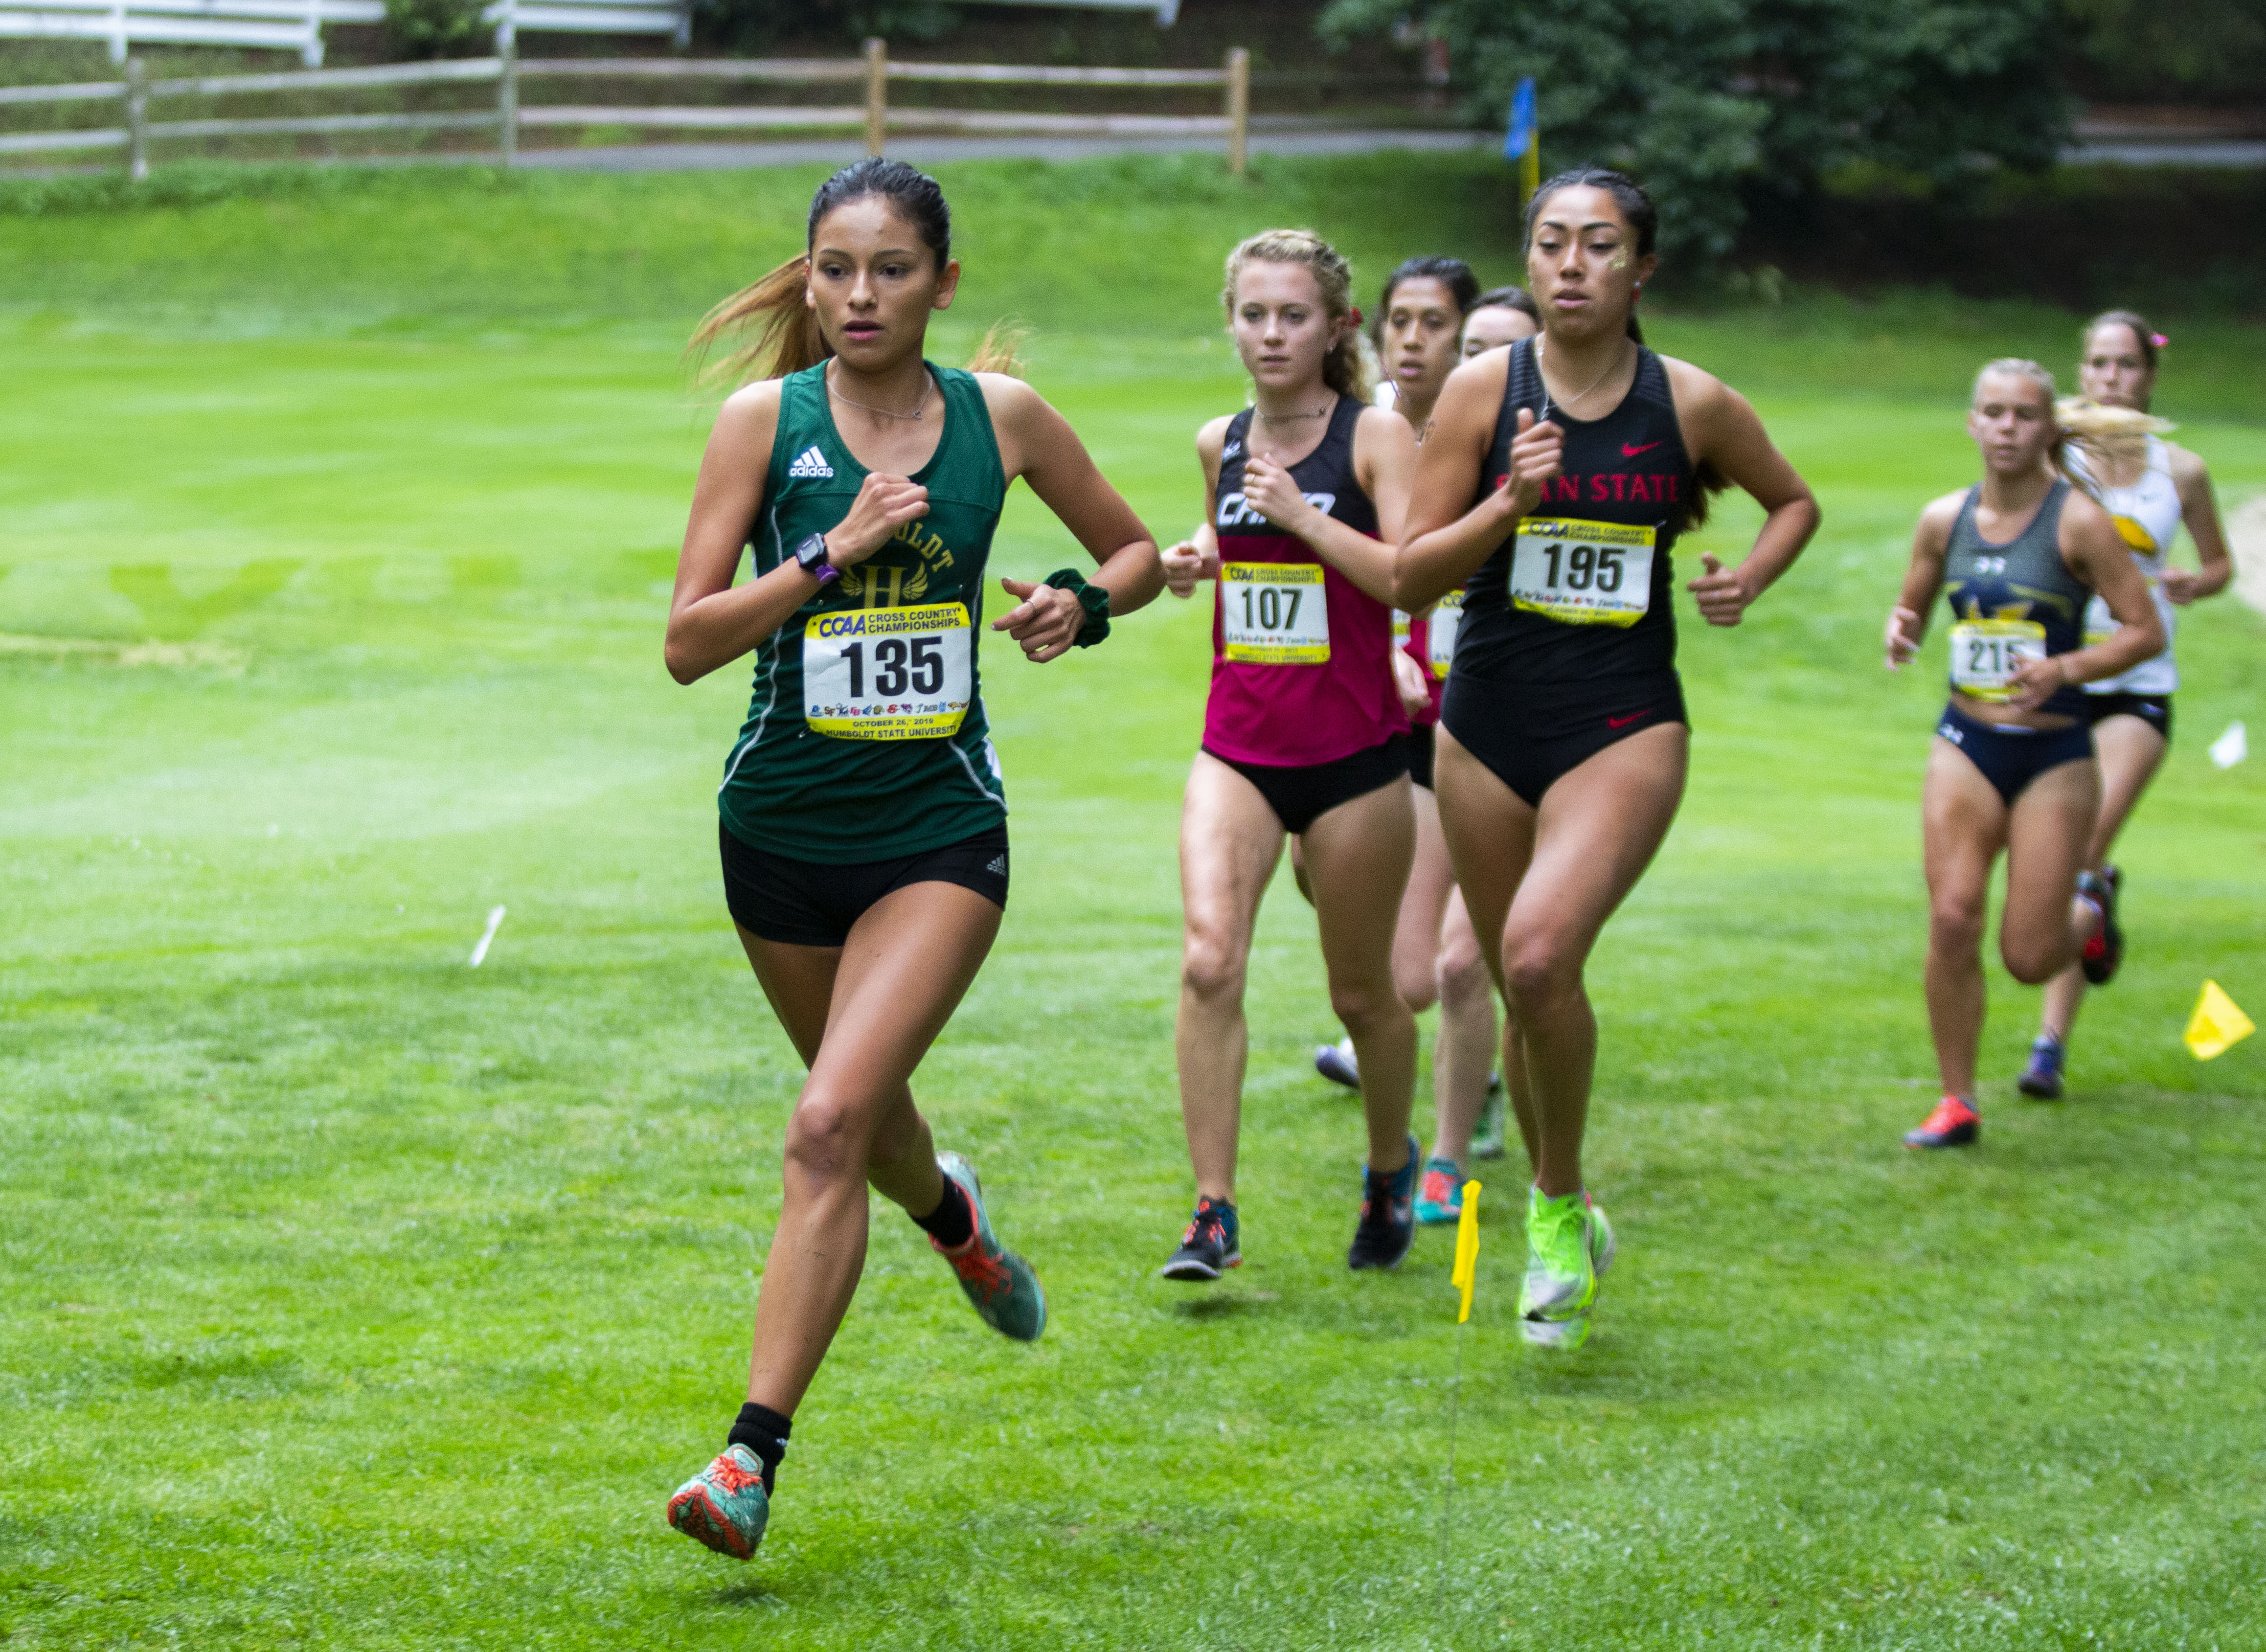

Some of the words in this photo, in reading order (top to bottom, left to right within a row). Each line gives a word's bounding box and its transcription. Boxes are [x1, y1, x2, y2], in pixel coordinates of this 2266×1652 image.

[789, 465, 834, 477] adidas
[1591, 473, 1678, 502] STATE
[1544, 542, 1627, 592] 195
[869, 613, 905, 622] CROSS
[910, 608, 957, 620] COUNTRY
[1242, 586, 1303, 630] 107
[820, 615, 866, 637] CCAA
[869, 617, 960, 633] CHAMPIONSHIPS
[841, 636, 944, 697] 135
[827, 729, 874, 738] HUMBOLDT
[877, 729, 905, 738] STATE
[909, 725, 957, 737] UNIVERSITY
